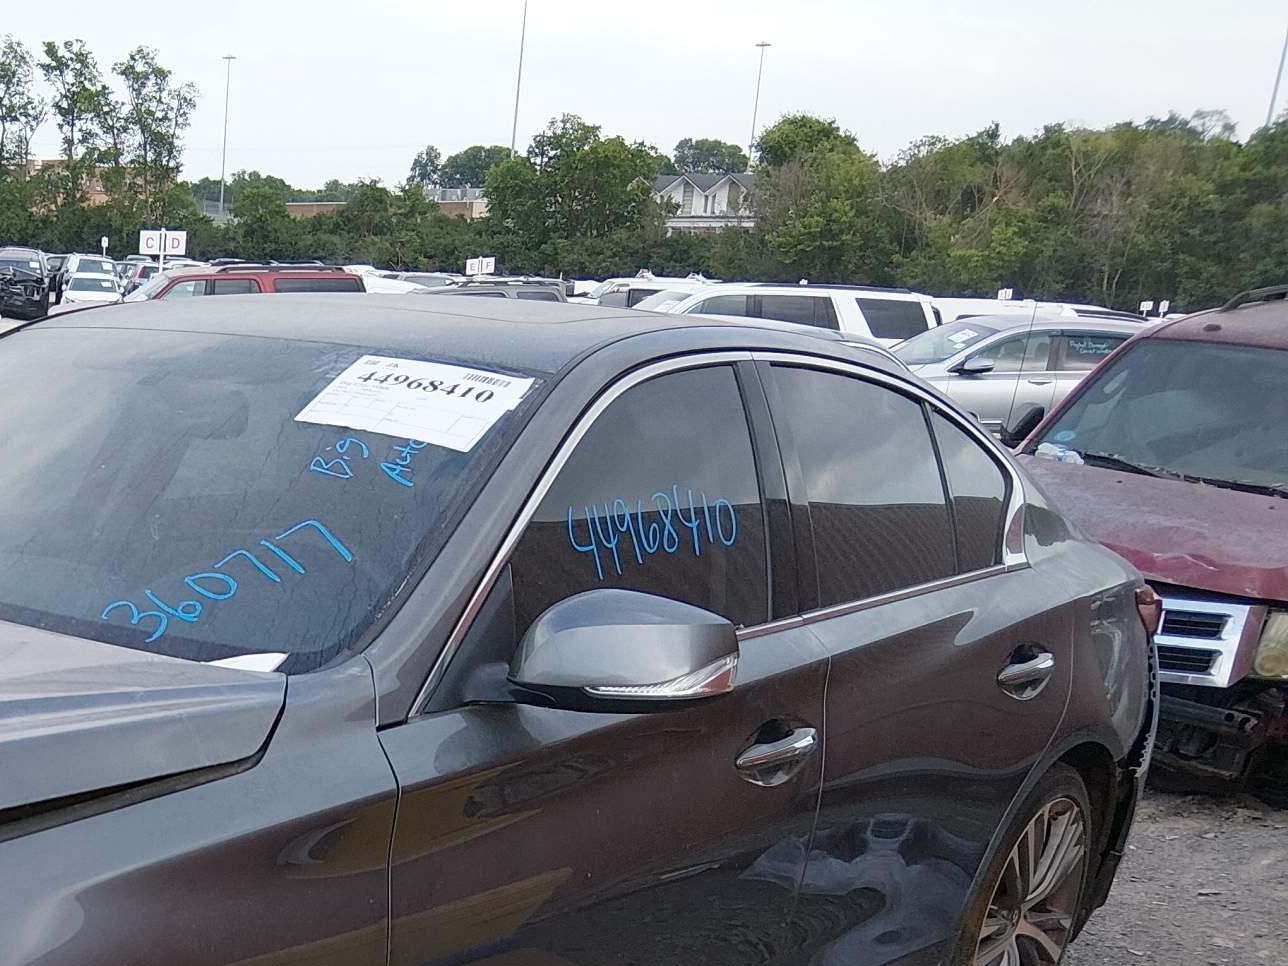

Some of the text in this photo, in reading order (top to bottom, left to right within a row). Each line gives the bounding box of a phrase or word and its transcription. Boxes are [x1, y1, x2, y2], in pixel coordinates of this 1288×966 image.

[145, 237, 180, 249] C D
[357, 370, 495, 403] 44968410
[310, 438, 369, 479] Big
[567, 483, 737, 581] 44968410
[101, 518, 353, 643] 360717
